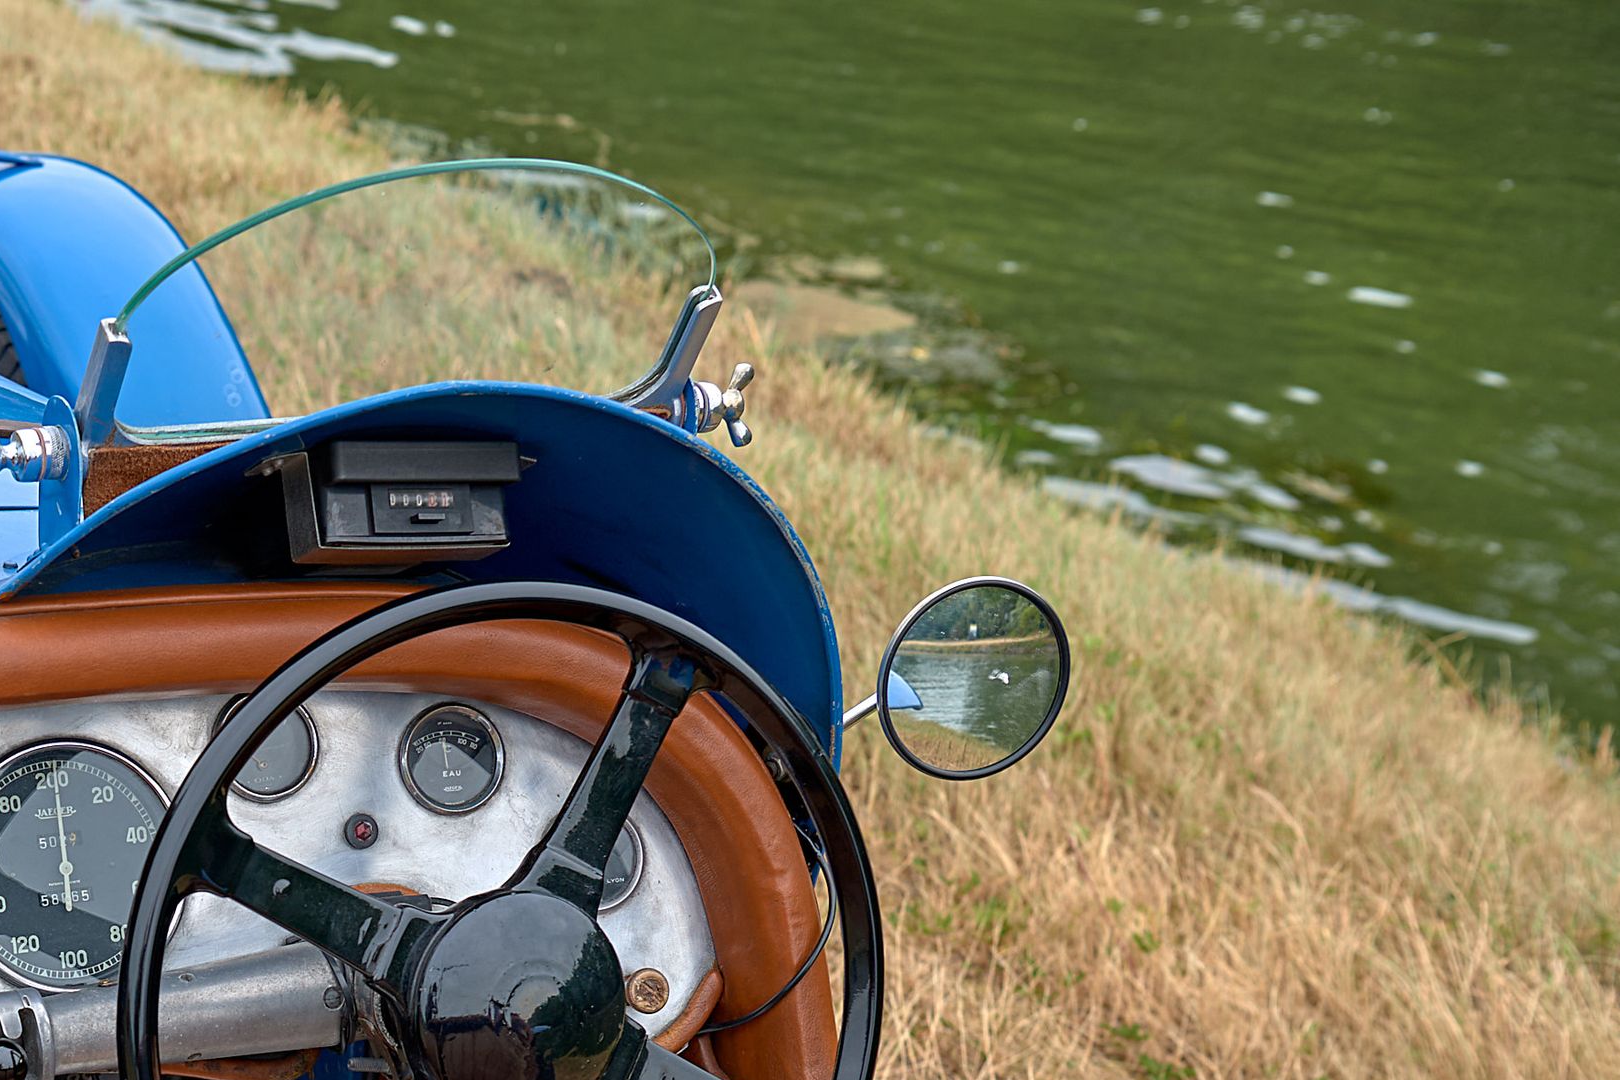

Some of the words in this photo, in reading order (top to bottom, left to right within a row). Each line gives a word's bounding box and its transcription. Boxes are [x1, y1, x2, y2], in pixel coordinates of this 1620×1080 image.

[35, 770, 69, 790] 200
[442, 770, 462, 778] EAU
[92, 786, 114, 804] 20
[126, 826, 148, 844] 40
[11, 934, 40, 955] 120
[59, 949, 88, 969] 100
